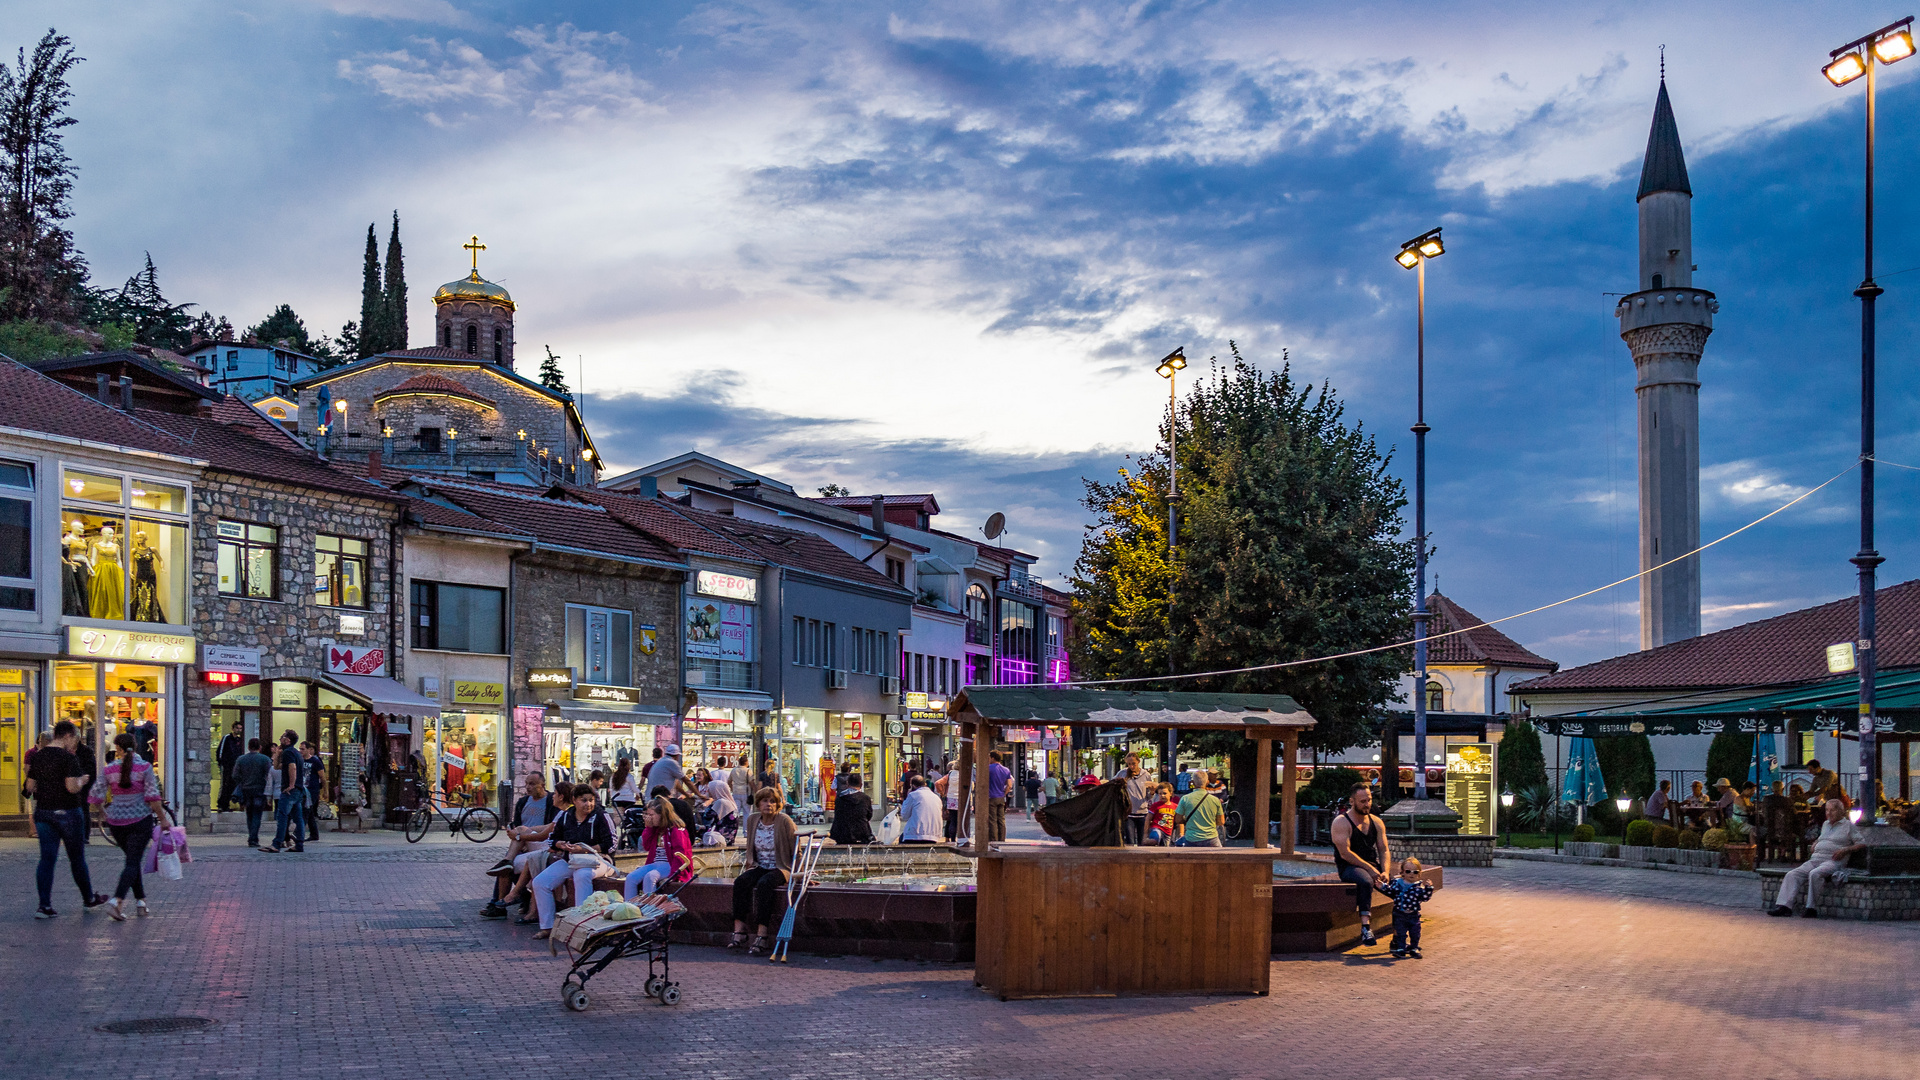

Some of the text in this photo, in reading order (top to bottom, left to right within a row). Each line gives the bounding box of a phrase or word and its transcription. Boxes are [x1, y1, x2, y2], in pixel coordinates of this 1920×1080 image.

[709, 575, 745, 590] SEBO
[81, 630, 185, 661] Ukras
[220, 652, 239, 660] СЕРВИС
[208, 659, 257, 669] МОБИЛНИ ТЕЛЕФОНИ
[457, 684, 481, 701] Lady
[481, 685, 502, 702] Shop
[1599, 724, 1628, 732] RESTORAN
[1698, 719, 1724, 732] SUNA
[711, 741, 746, 751] SEBO
